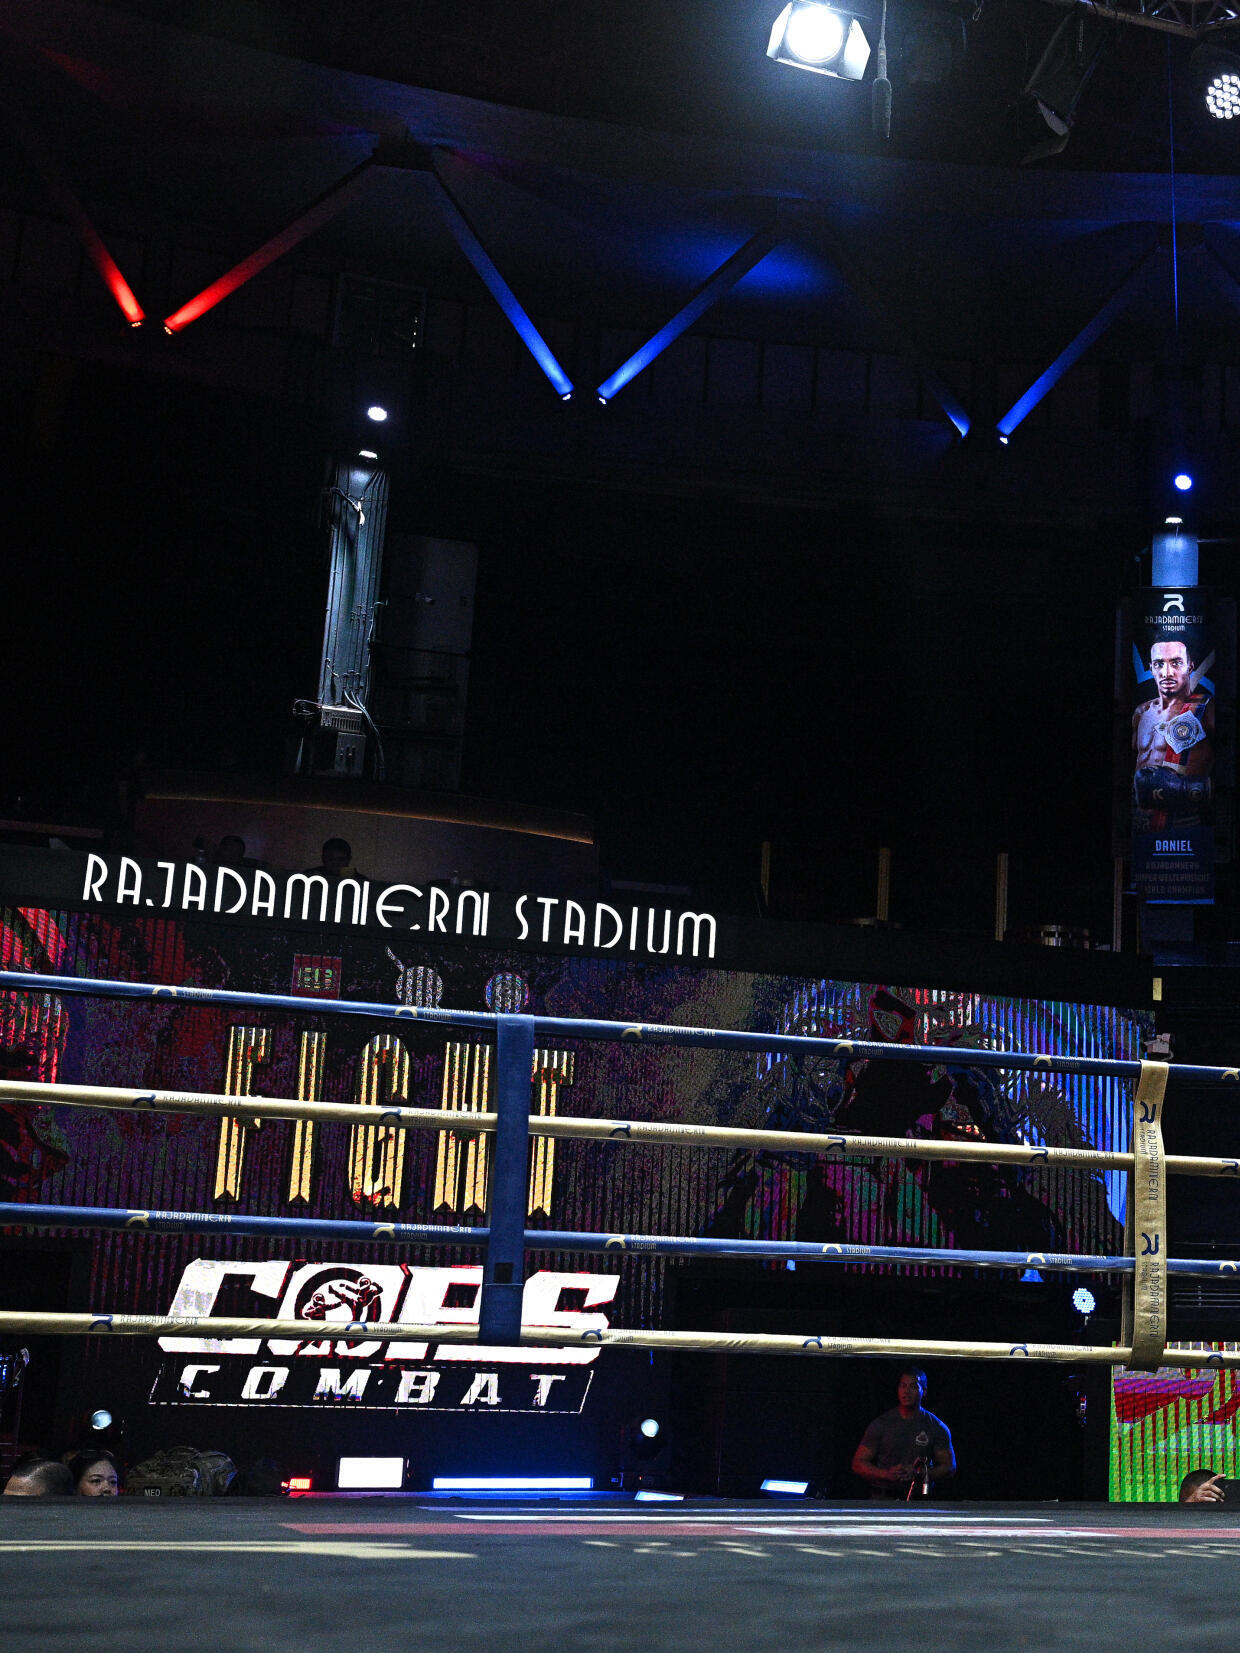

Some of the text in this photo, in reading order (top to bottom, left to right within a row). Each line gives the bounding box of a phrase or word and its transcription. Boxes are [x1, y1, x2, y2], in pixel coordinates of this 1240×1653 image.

[1155, 840, 1192, 851] DANIEL
[82, 853, 716, 958] RAJADAMNERN STADIUM
[214, 1025, 575, 1217] FIGHT
[178, 1364, 566, 1407] COMBAT
[144, 1489, 161, 1497] MED
